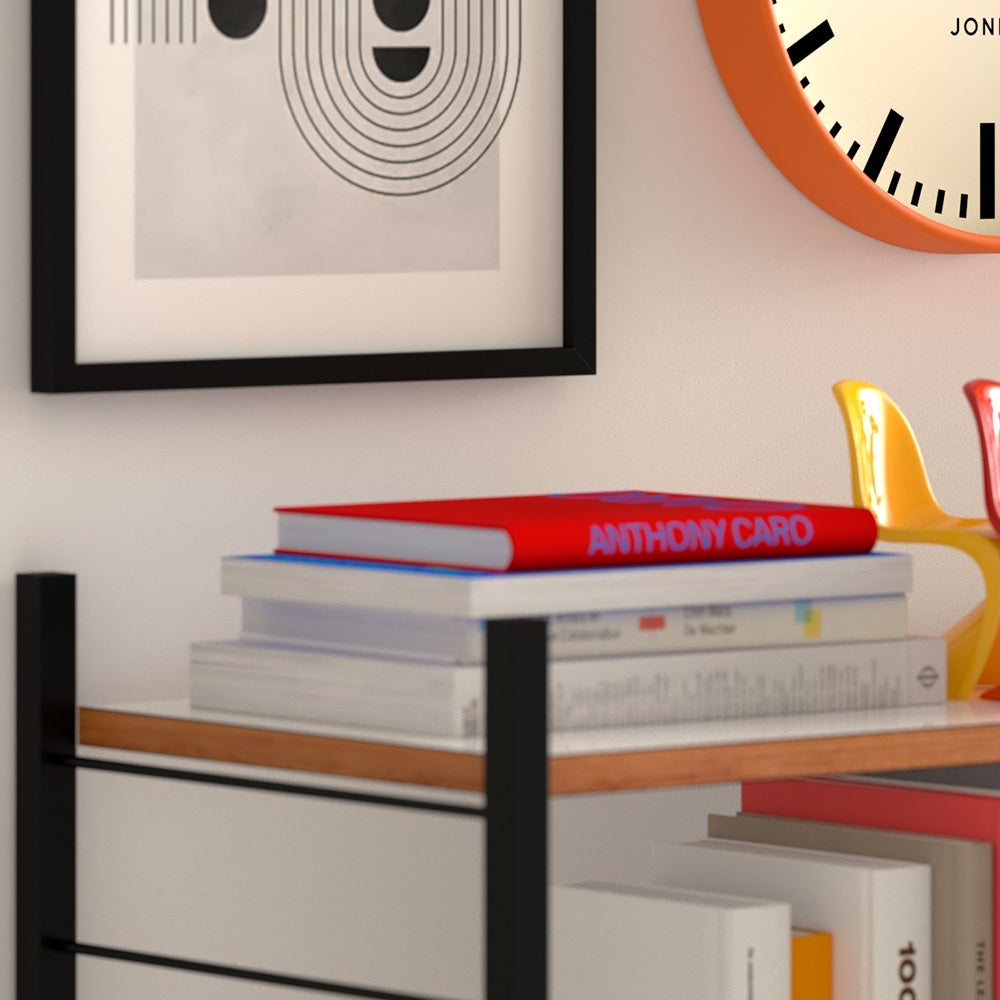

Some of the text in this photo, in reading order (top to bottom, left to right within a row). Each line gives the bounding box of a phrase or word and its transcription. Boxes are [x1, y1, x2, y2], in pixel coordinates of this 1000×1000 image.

[586, 514, 814, 556] ANTHONY CARO
[975, 941, 986, 973] THE
